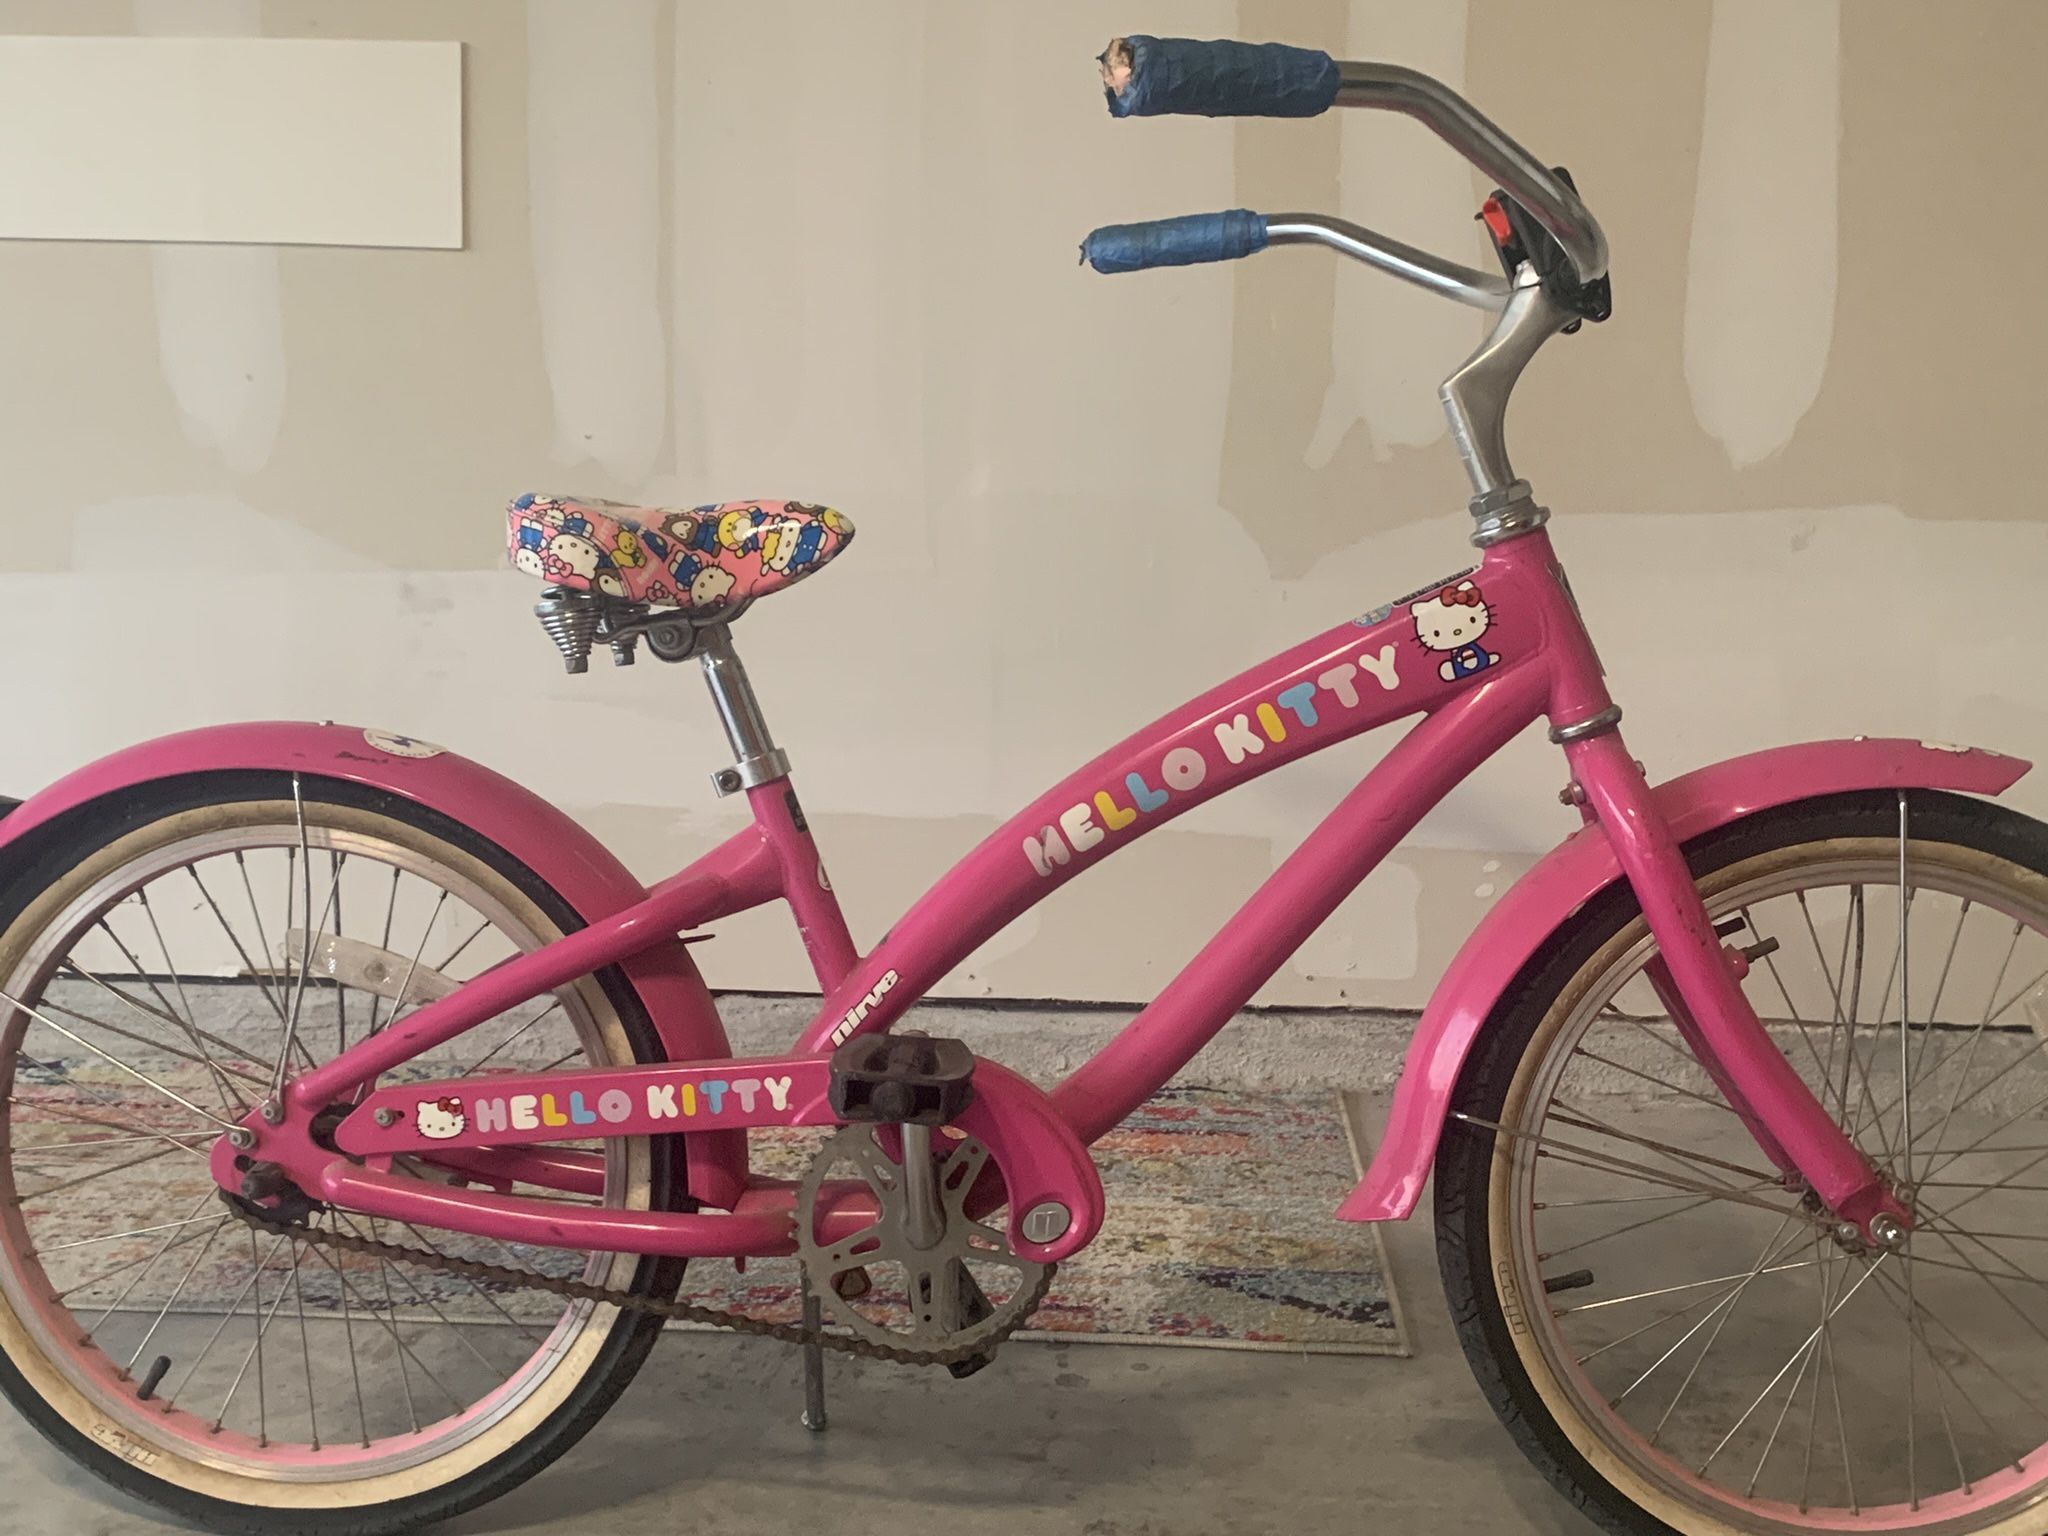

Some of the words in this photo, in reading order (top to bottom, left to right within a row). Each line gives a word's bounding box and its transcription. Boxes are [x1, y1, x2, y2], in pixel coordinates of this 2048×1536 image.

[1022, 747, 1207, 877] HELLO
[1213, 644, 1400, 764] KITTY
[475, 1089, 633, 1133] HELLO
[646, 1076, 793, 1119] KITTY
